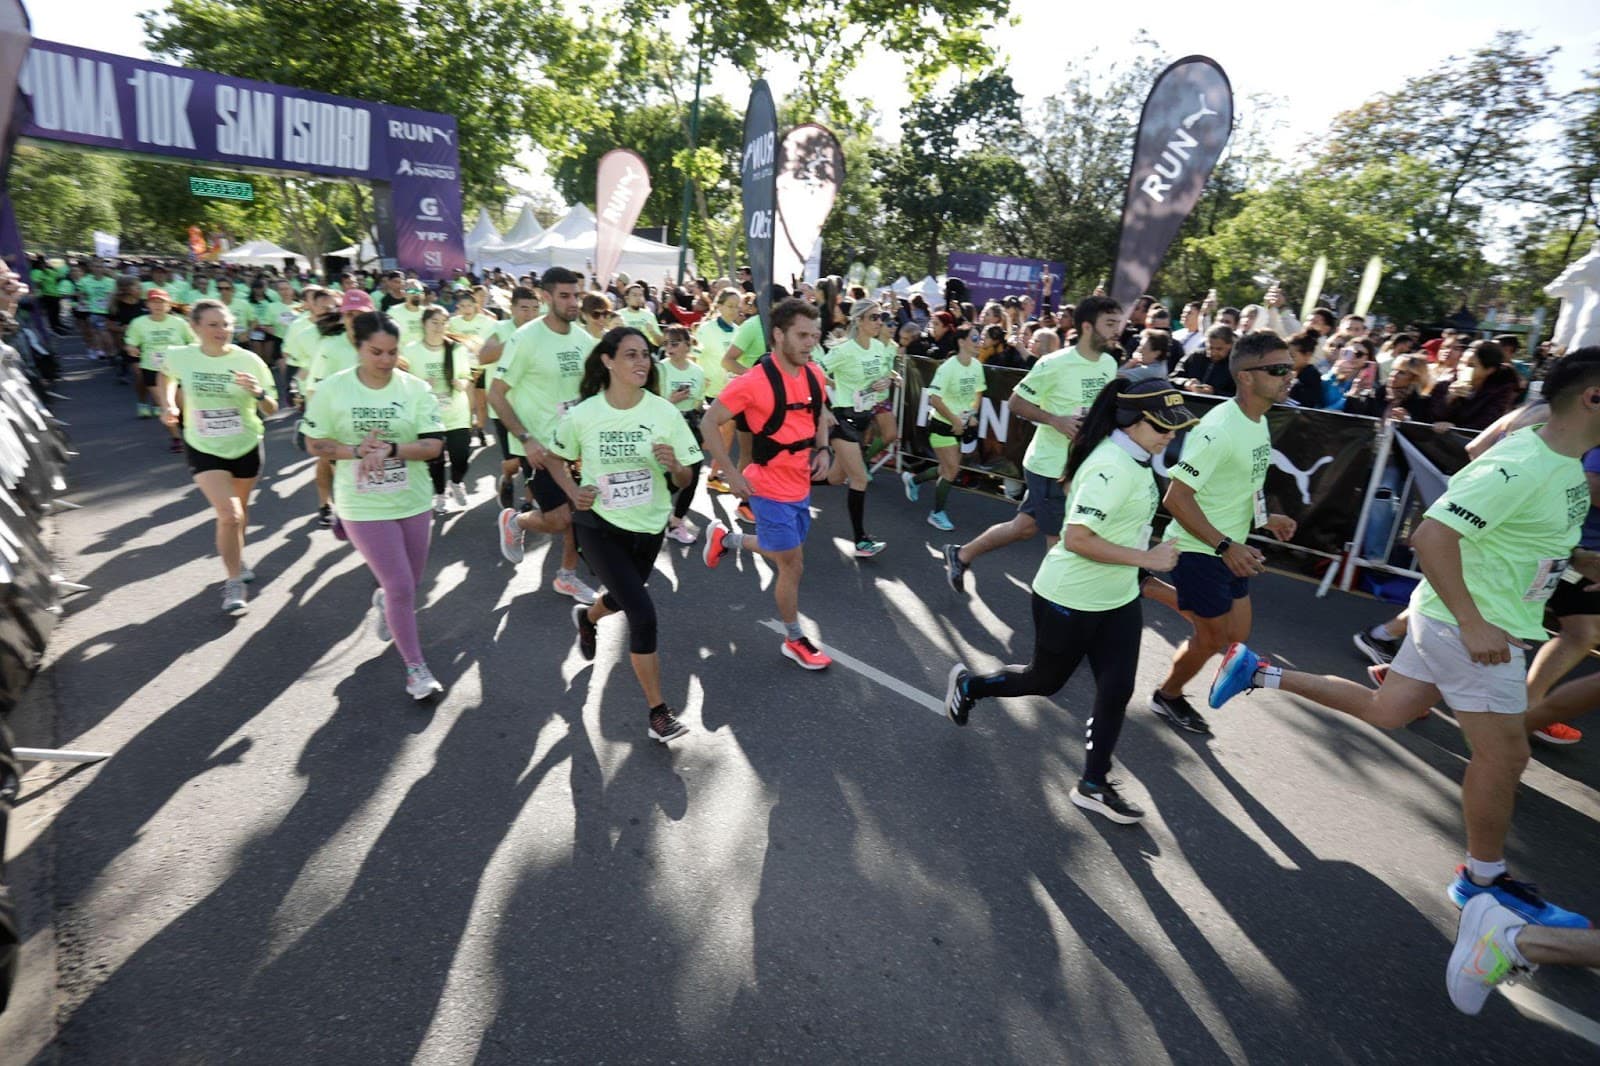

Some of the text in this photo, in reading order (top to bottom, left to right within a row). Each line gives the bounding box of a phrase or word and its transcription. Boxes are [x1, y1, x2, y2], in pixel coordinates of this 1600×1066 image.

[126, 68, 197, 150] 10K
[215, 84, 275, 160] SAN
[282, 95, 371, 171] ISIDRO
[388, 119, 434, 143] RUN
[1141, 127, 1198, 203] RUN
[419, 197, 438, 217] G
[415, 230, 449, 242] YPF
[600, 444, 640, 457] FASTER.
